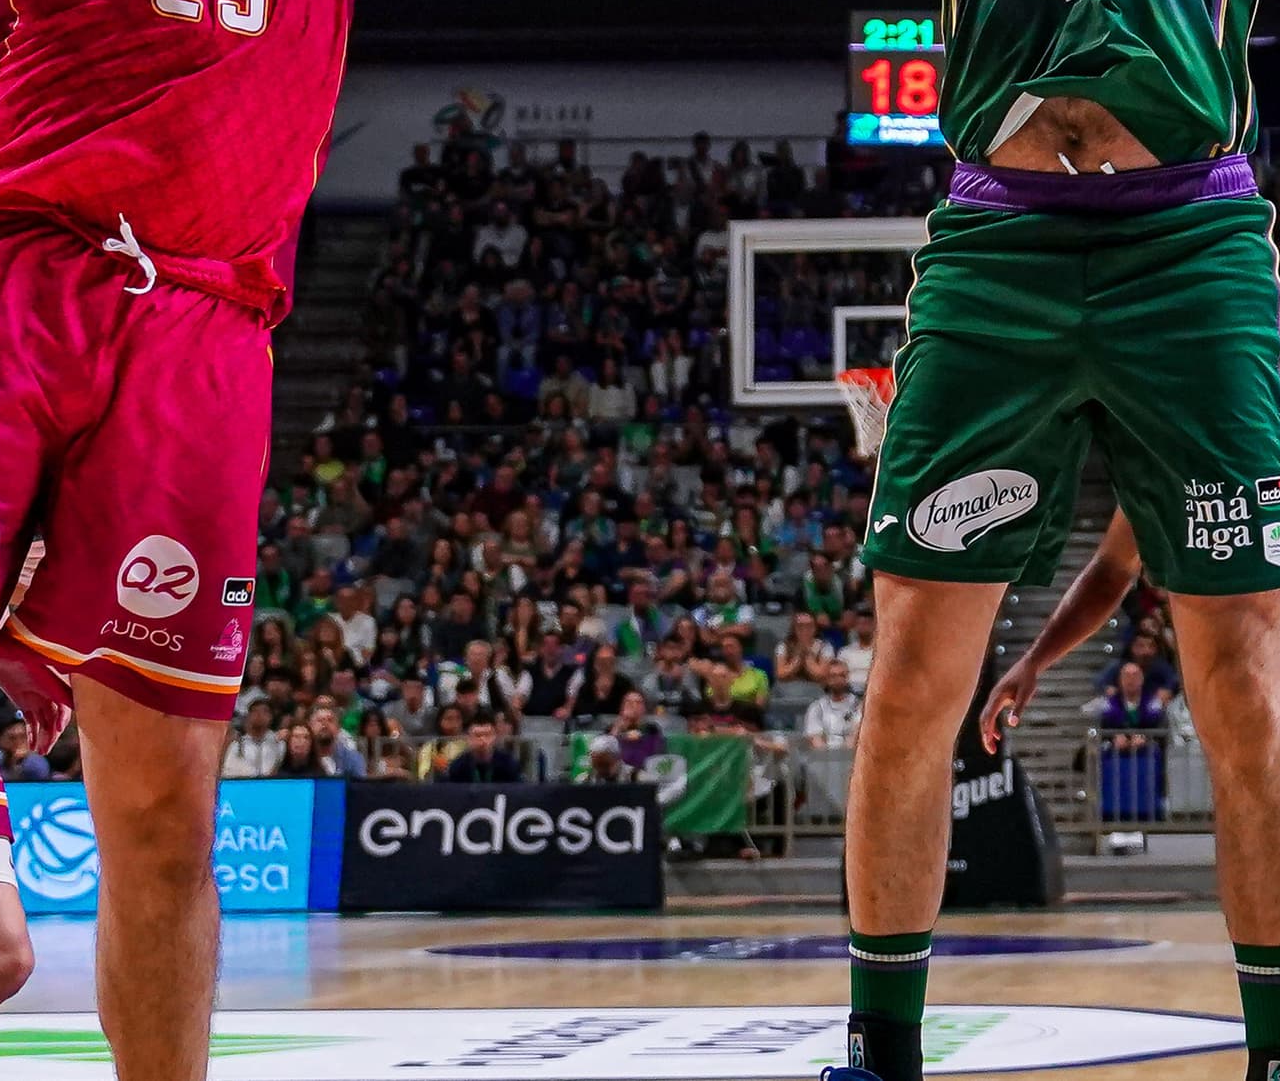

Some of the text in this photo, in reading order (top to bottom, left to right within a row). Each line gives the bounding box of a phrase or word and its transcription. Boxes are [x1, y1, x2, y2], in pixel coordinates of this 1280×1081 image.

[863, 18, 935, 51] 2:21
[861, 58, 939, 116] 18
[919, 475, 1034, 537] famadesa
[121, 555, 196, 601] Q2
[226, 588, 249, 603] acb
[952, 758, 1014, 820] guel
[358, 793, 646, 857] endesa
[215, 862, 289, 893] esa
